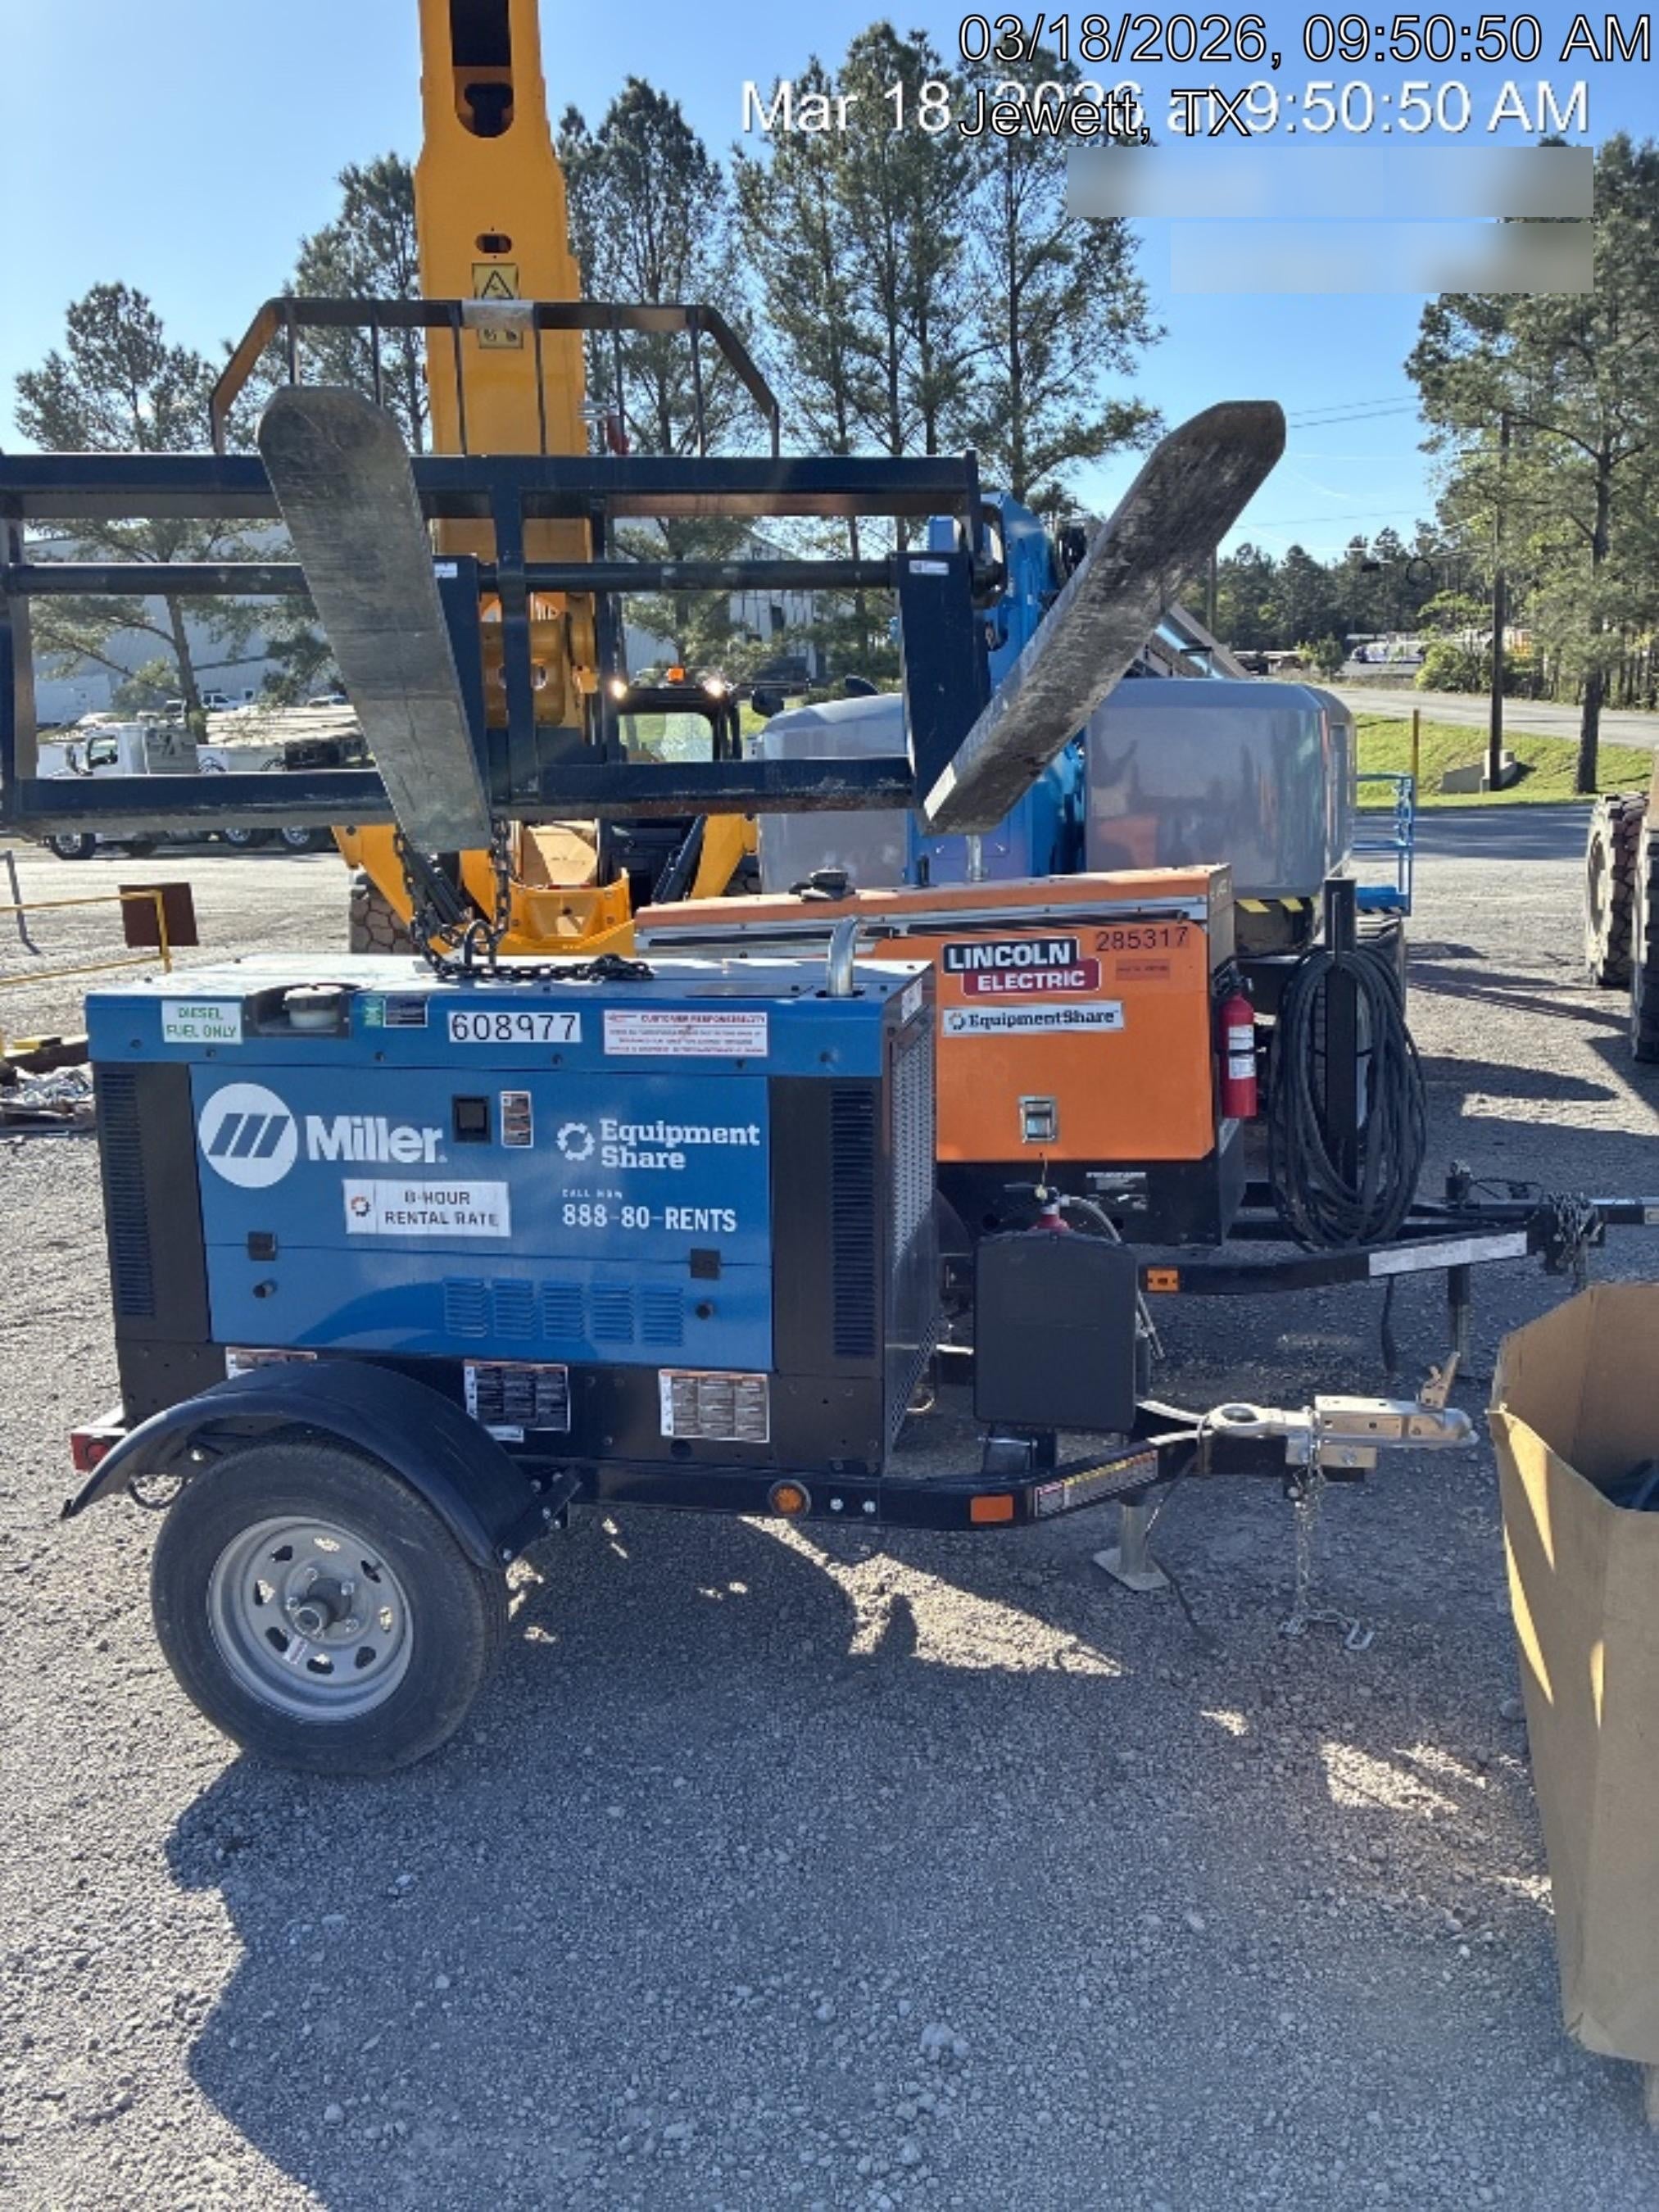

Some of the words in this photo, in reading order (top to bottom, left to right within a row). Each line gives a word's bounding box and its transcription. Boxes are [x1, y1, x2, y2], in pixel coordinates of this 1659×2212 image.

[1095, 926, 1189, 952] 285317
[948, 943, 1070, 969] LINCOLN
[977, 970, 1086, 992] ELECTRIC
[178, 1007, 224, 1021] DIESEL
[968, 1009, 1114, 1030] EquipmentShare
[166, 1024, 199, 1038] FUEL
[203, 1024, 237, 1039] ONLY
[451, 1013, 577, 1041] 608977
[306, 1115, 443, 1163] Miller
[600, 1118, 760, 1148] Equipment
[601, 1146, 686, 1170] Share
[562, 1189, 591, 1199] CALL
[385, 1211, 451, 1226] RENTAL
[455, 1213, 500, 1228] RATE
